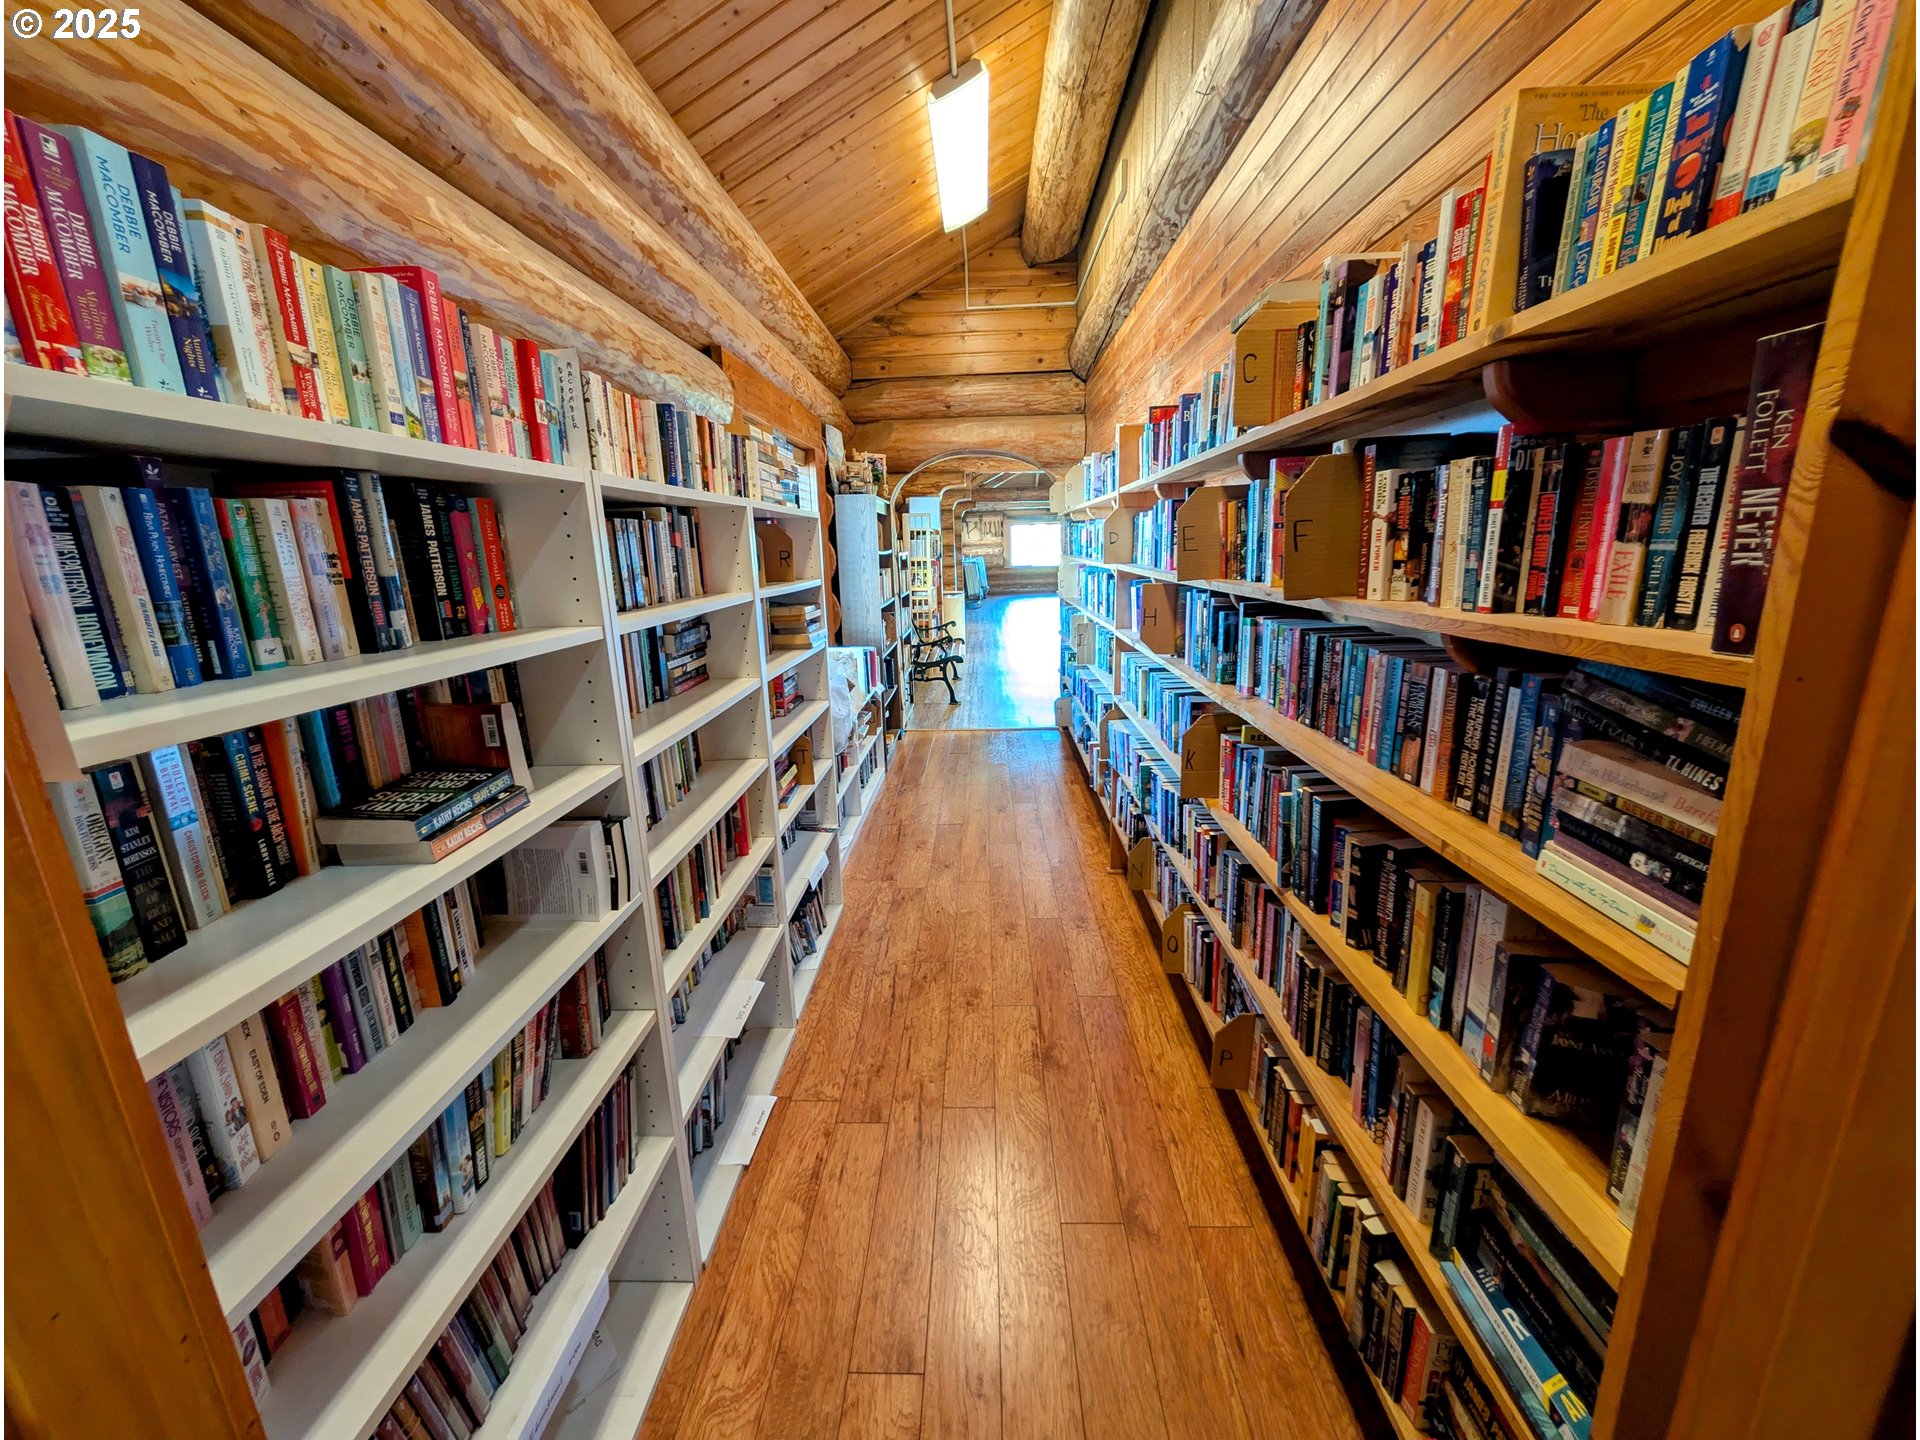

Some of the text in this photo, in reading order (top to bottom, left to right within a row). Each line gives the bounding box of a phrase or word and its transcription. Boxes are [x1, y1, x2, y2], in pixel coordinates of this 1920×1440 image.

[1806, 31, 1832, 91] CARR
[1822, 20, 1848, 85] ROBYN
[1847, 36, 1866, 64] The
[1838, 63, 1859, 102] Trash
[1580, 102, 1609, 121] The
[1733, 49, 1767, 169] MARY HIGGINS CLARK
[1641, 108, 1661, 171] JILL CHURCHILL
[1585, 142, 1610, 211] JILL CHURCHILL
[1600, 127, 1628, 229] The Class Menagerie
[96, 155, 131, 254] MACOMBER
[117, 183, 142, 240] DEBBIE
[147, 190, 173, 264] MACOMBER
[4, 182, 40, 277] MACOMBER
[22, 206, 52, 264] DEBBIE
[45, 186, 84, 280] MACOMBER
[68, 211, 97, 269] DEBBIE
[163, 210, 182, 254] DEBBIE
[1451, 227, 1464, 262] COULTER
[1475, 203, 1499, 316] JIMMY CARTER
[220, 247, 243, 334] DEBBIE MACOMBER
[276, 250, 299, 342] DEBBIE MACOMBER
[1421, 258, 1436, 318] TOM CLANCY
[78, 295, 91, 330] Brides
[85, 288, 105, 343] Manning
[336, 279, 356, 349] MACOMBER
[347, 297, 361, 338] DEBBIE
[183, 336, 196, 368] Nights
[192, 334, 207, 374] Autumn
[409, 302, 427, 376] DEBBIE MACOMBER
[426, 280, 452, 399] DEBBIE MACOMBER
[481, 334, 494, 390] MACOMBER
[489, 349, 498, 378] DEBBIE
[498, 359, 507, 392] DEBBIE
[503, 348, 514, 399] MACOMBER
[509, 361, 517, 388] DEBBIE
[530, 358, 540, 396] MACOMBER
[1243, 353, 1257, 383] C
[305, 373, 316, 410] WINDOW
[1744, 389, 1780, 473] FOLLETT
[1771, 408, 1795, 450] KEN
[1067, 483, 1073, 492] B
[1365, 452, 1373, 493] STORM
[1437, 492, 1448, 536] MEDALON
[1532, 494, 1556, 568] COVER STORY
[1574, 466, 1599, 553] JOSEPH FINDER
[1730, 487, 1782, 567] NEVER
[143, 512, 173, 598] BELVA PLAIN HOMECOMING
[281, 519, 295, 567] Geoffrey
[420, 504, 448, 596] JAMES PATTERSON
[485, 518, 501, 580] Jodi Picoult
[1110, 532, 1119, 544] D
[1183, 526, 1198, 551] E
[1294, 519, 1313, 552] F
[1373, 544, 1381, 572] POWER
[1642, 453, 1684, 616] JOY FIELDING STILL LIFE
[1674, 466, 1720, 615] THE DECEIVER FREDERICK FORSYTH
[157, 501, 204, 663] FATAL HARVEST CATHERINE PALMER
[350, 495, 384, 626] JAMES PATTERSON HUSH
[441, 510, 465, 619] JAMES PATTERSON 23
[779, 550, 790, 568] R
[1538, 571, 1547, 595] COLIN
[1607, 551, 1634, 600] EXILE
[1528, 570, 1538, 600] FORBES
[51, 531, 118, 690] JAMES PATTERSON HONEYMOON
[1143, 608, 1157, 626] H
[223, 616, 240, 661] PEMBROOKE
[233, 627, 242, 645] KATE
[1406, 684, 1418, 726] HAMILTON
[1442, 685, 1454, 742] LINDA HOWARD
[1475, 713, 1483, 750] NUMBER
[1485, 683, 1503, 777] HEART-SHAPED BOX
[1514, 695, 1534, 776] MARINE ONE
[797, 749, 808, 765] T
[1185, 749, 1196, 771] K
[1458, 750, 1468, 785] HEINLEIN
[160, 767, 178, 812] BETRAYAL
[170, 763, 191, 809] RULES OF
[235, 753, 256, 814] CRIME SCENE
[249, 743, 285, 843] IN THE SHADOW OF THE ARCH
[432, 807, 453, 829] KATHY
[451, 797, 472, 822] REICHS
[473, 785, 489, 804] GRAVE
[489, 775, 512, 796] SECRETS
[84, 813, 115, 865] OREGON!
[120, 835, 152, 853] STANLEY
[125, 825, 140, 838] KIM
[446, 820, 483, 850] KATHY REICHS
[1623, 800, 1663, 826] NEVER
[1668, 817, 1694, 841] SAY
[123, 846, 156, 866] ROBINSON
[184, 830, 209, 901] CHRISTOPHER REICH
[1130, 863, 1143, 879] N
[1377, 869, 1388, 919] FRANKENSTEIN
[1167, 935, 1178, 953] O
[1488, 914, 1502, 960] KAREN
[365, 1004, 382, 1051] QUICKSILVER
[250, 1049, 270, 1105] EAST OF EDEN
[1220, 1050, 1232, 1066] P
